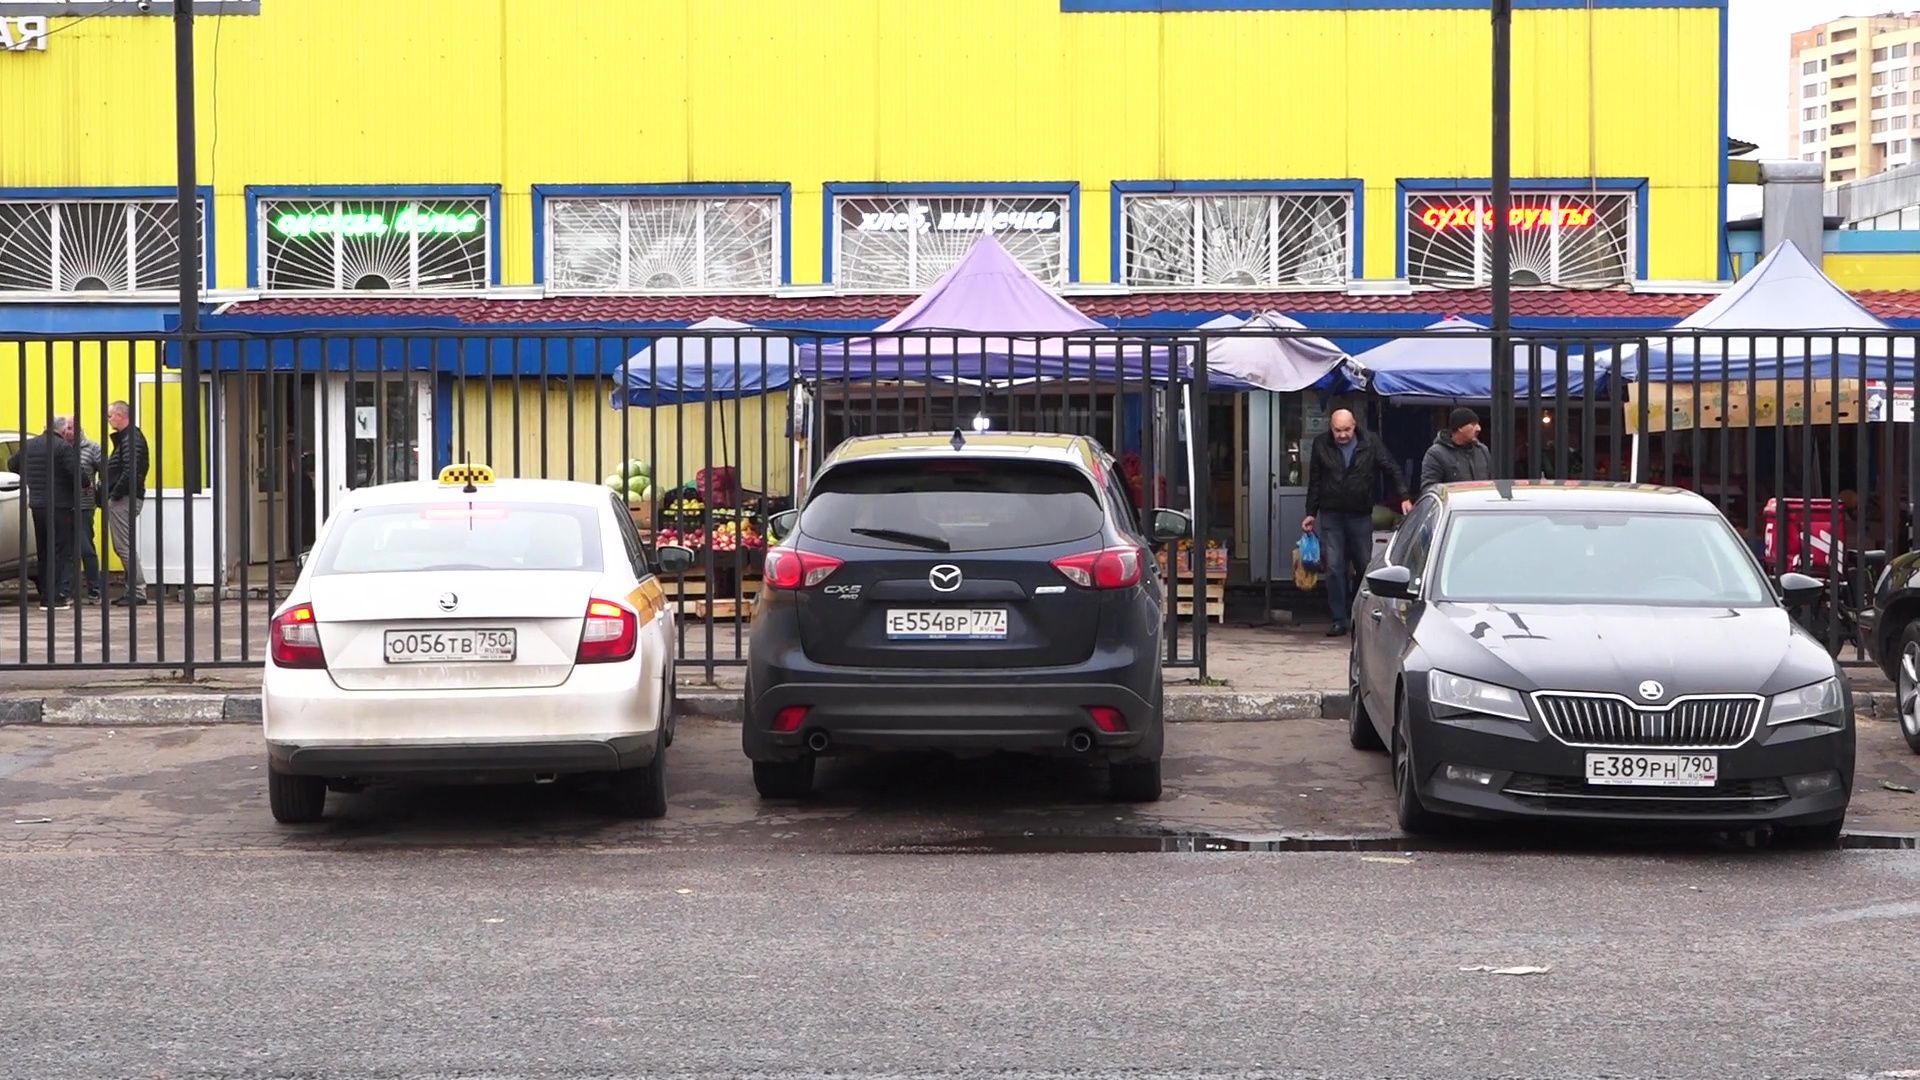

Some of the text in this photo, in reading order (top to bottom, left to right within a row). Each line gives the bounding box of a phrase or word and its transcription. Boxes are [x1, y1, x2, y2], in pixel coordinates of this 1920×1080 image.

[858, 206, 931, 235] хлеб,
[823, 584, 862, 594] CX-5
[893, 611, 1001, 631] Е554ВР 777
[391, 632, 508, 654] О056ТВ 750
[1593, 756, 1712, 778] Е389РН 790
